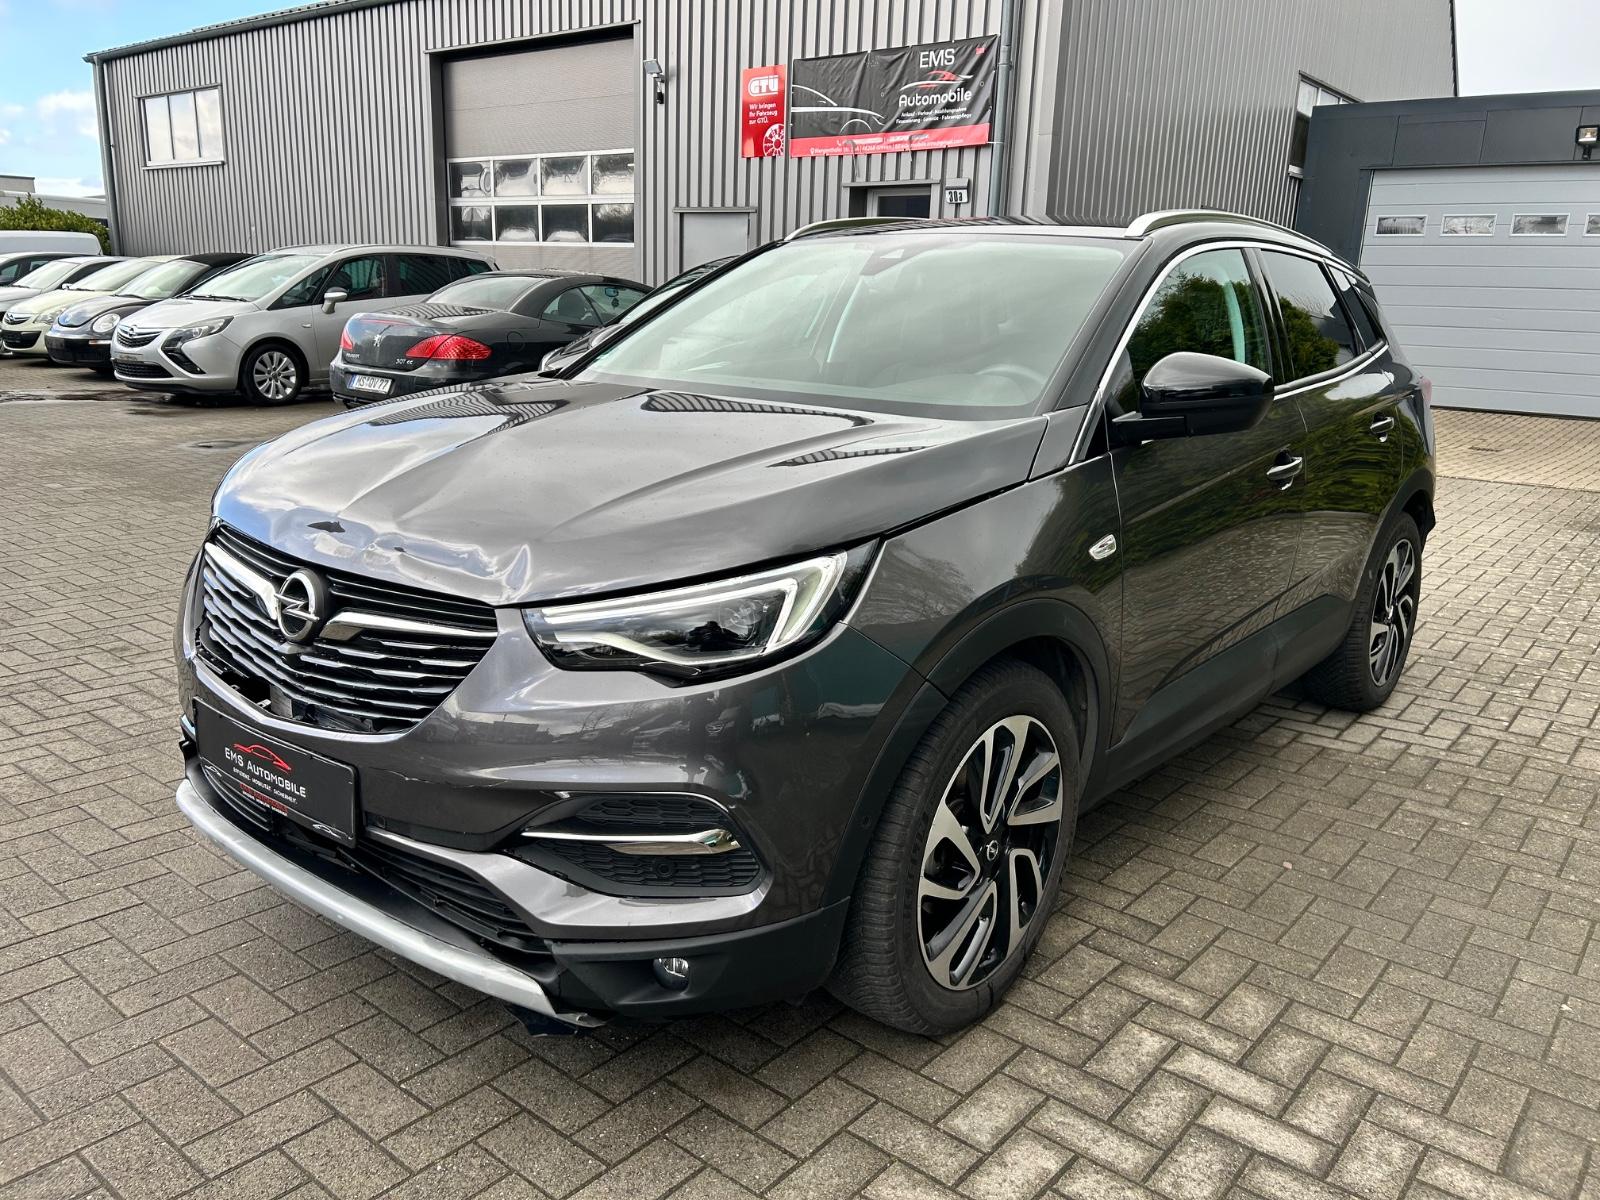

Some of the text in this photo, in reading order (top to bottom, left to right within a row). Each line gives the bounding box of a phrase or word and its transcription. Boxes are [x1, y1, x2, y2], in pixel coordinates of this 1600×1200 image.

[919, 48, 955, 68] EMS
[750, 75, 779, 94] GTÜ
[759, 102, 777, 110] bringen
[899, 88, 972, 108] Automobile
[949, 191, 963, 202] 30a
[225, 747, 306, 798] EMS AUTOMOBILE
